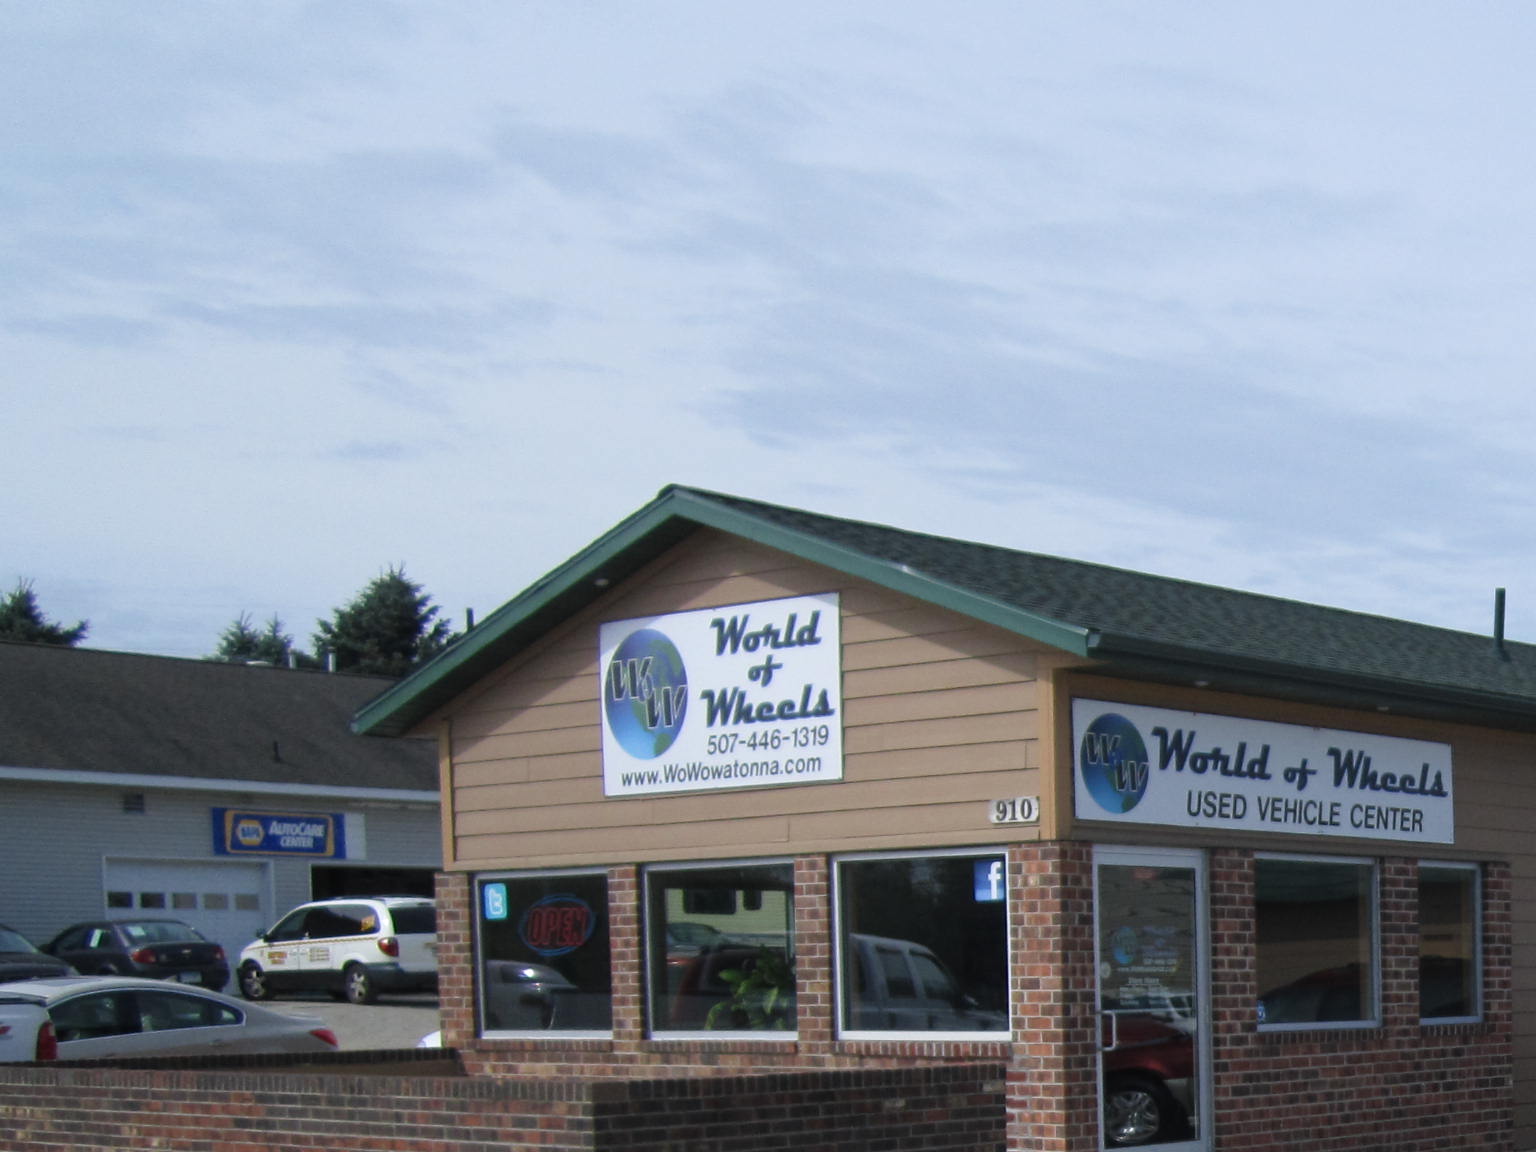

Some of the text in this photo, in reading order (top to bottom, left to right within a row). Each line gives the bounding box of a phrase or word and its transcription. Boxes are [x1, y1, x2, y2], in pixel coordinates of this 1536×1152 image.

[710, 610, 822, 656] World
[748, 654, 783, 687] of
[700, 684, 836, 728] Wheels
[707, 725, 829, 755] 507-446-1319
[621, 757, 822, 786] www.WoWowatonna.com
[1151, 726, 1448, 798] World of Wheels
[996, 799, 1032, 821] 910
[1187, 790, 1424, 832] USED VEHICLE CENTER
[280, 836, 314, 848] CENTER
[528, 906, 589, 946] OPEN
